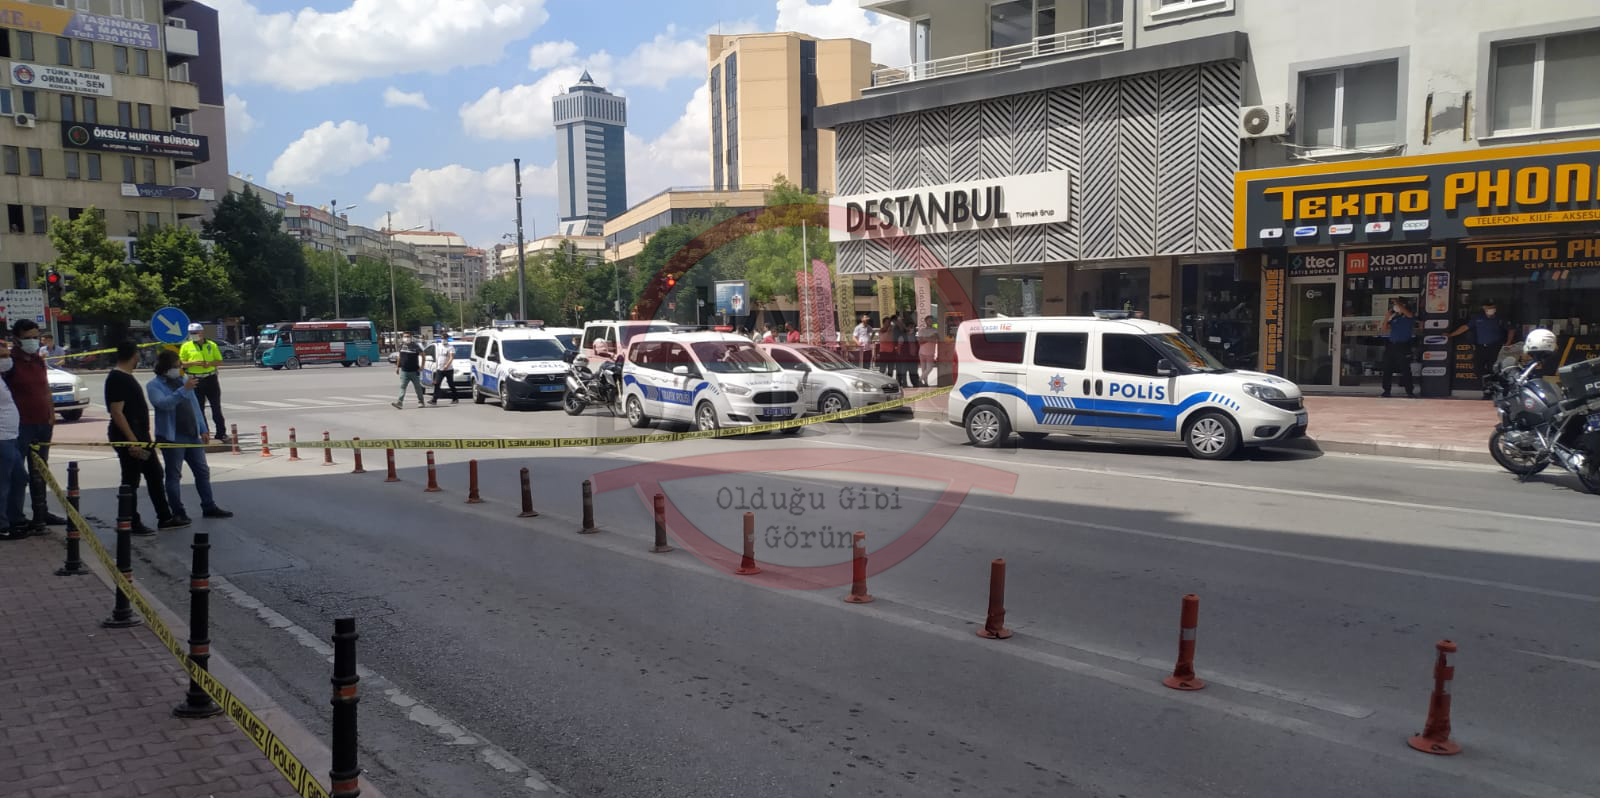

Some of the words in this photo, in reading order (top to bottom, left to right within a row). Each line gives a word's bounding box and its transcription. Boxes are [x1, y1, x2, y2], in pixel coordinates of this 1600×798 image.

[40, 74, 78, 86] ORMAN
[86, 80, 105, 89] SEN
[45, 68, 70, 77] TÜRK
[93, 127, 127, 140] ÖKSÜZ
[128, 132, 161, 143] HUKUK
[163, 135, 200, 147] BÜROSU
[1443, 162, 1600, 210] PHON
[846, 185, 1009, 233] DESTANBUL
[1476, 217, 1519, 226] TELEFON
[1530, 213, 1553, 222] KILIF
[1305, 255, 1336, 269] ttec
[1109, 381, 1165, 400] POLİS
[273, 744, 297, 782] POLİS
